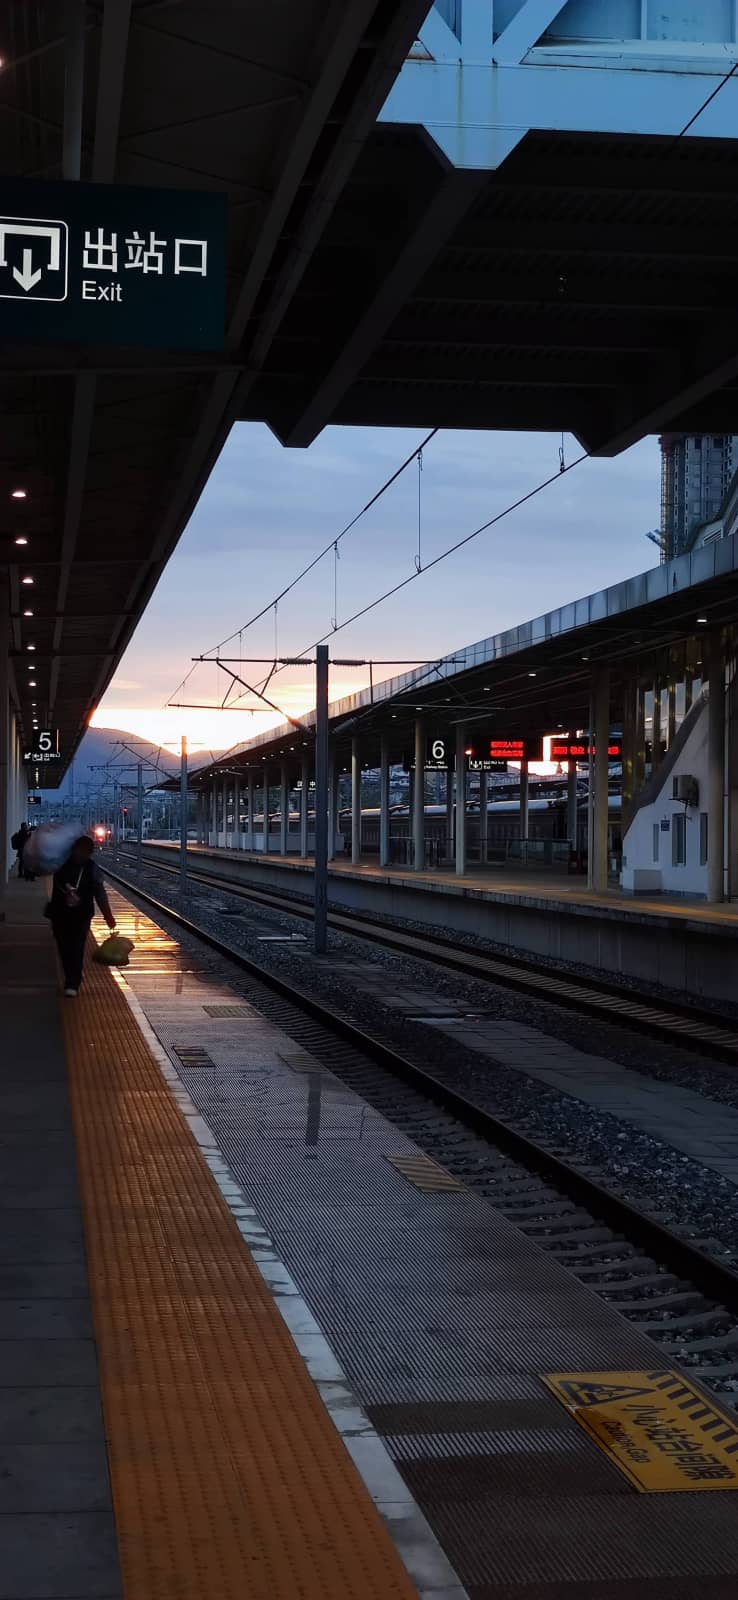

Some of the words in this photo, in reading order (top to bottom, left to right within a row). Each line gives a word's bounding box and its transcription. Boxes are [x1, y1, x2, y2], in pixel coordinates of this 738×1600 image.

[82, 227, 208, 277] 出站口
[82, 280, 123, 302] Exit
[38, 731, 52, 751] 5
[432, 739, 445, 759] 6
[622, 1403, 736, 1481] 小心站台间隙
